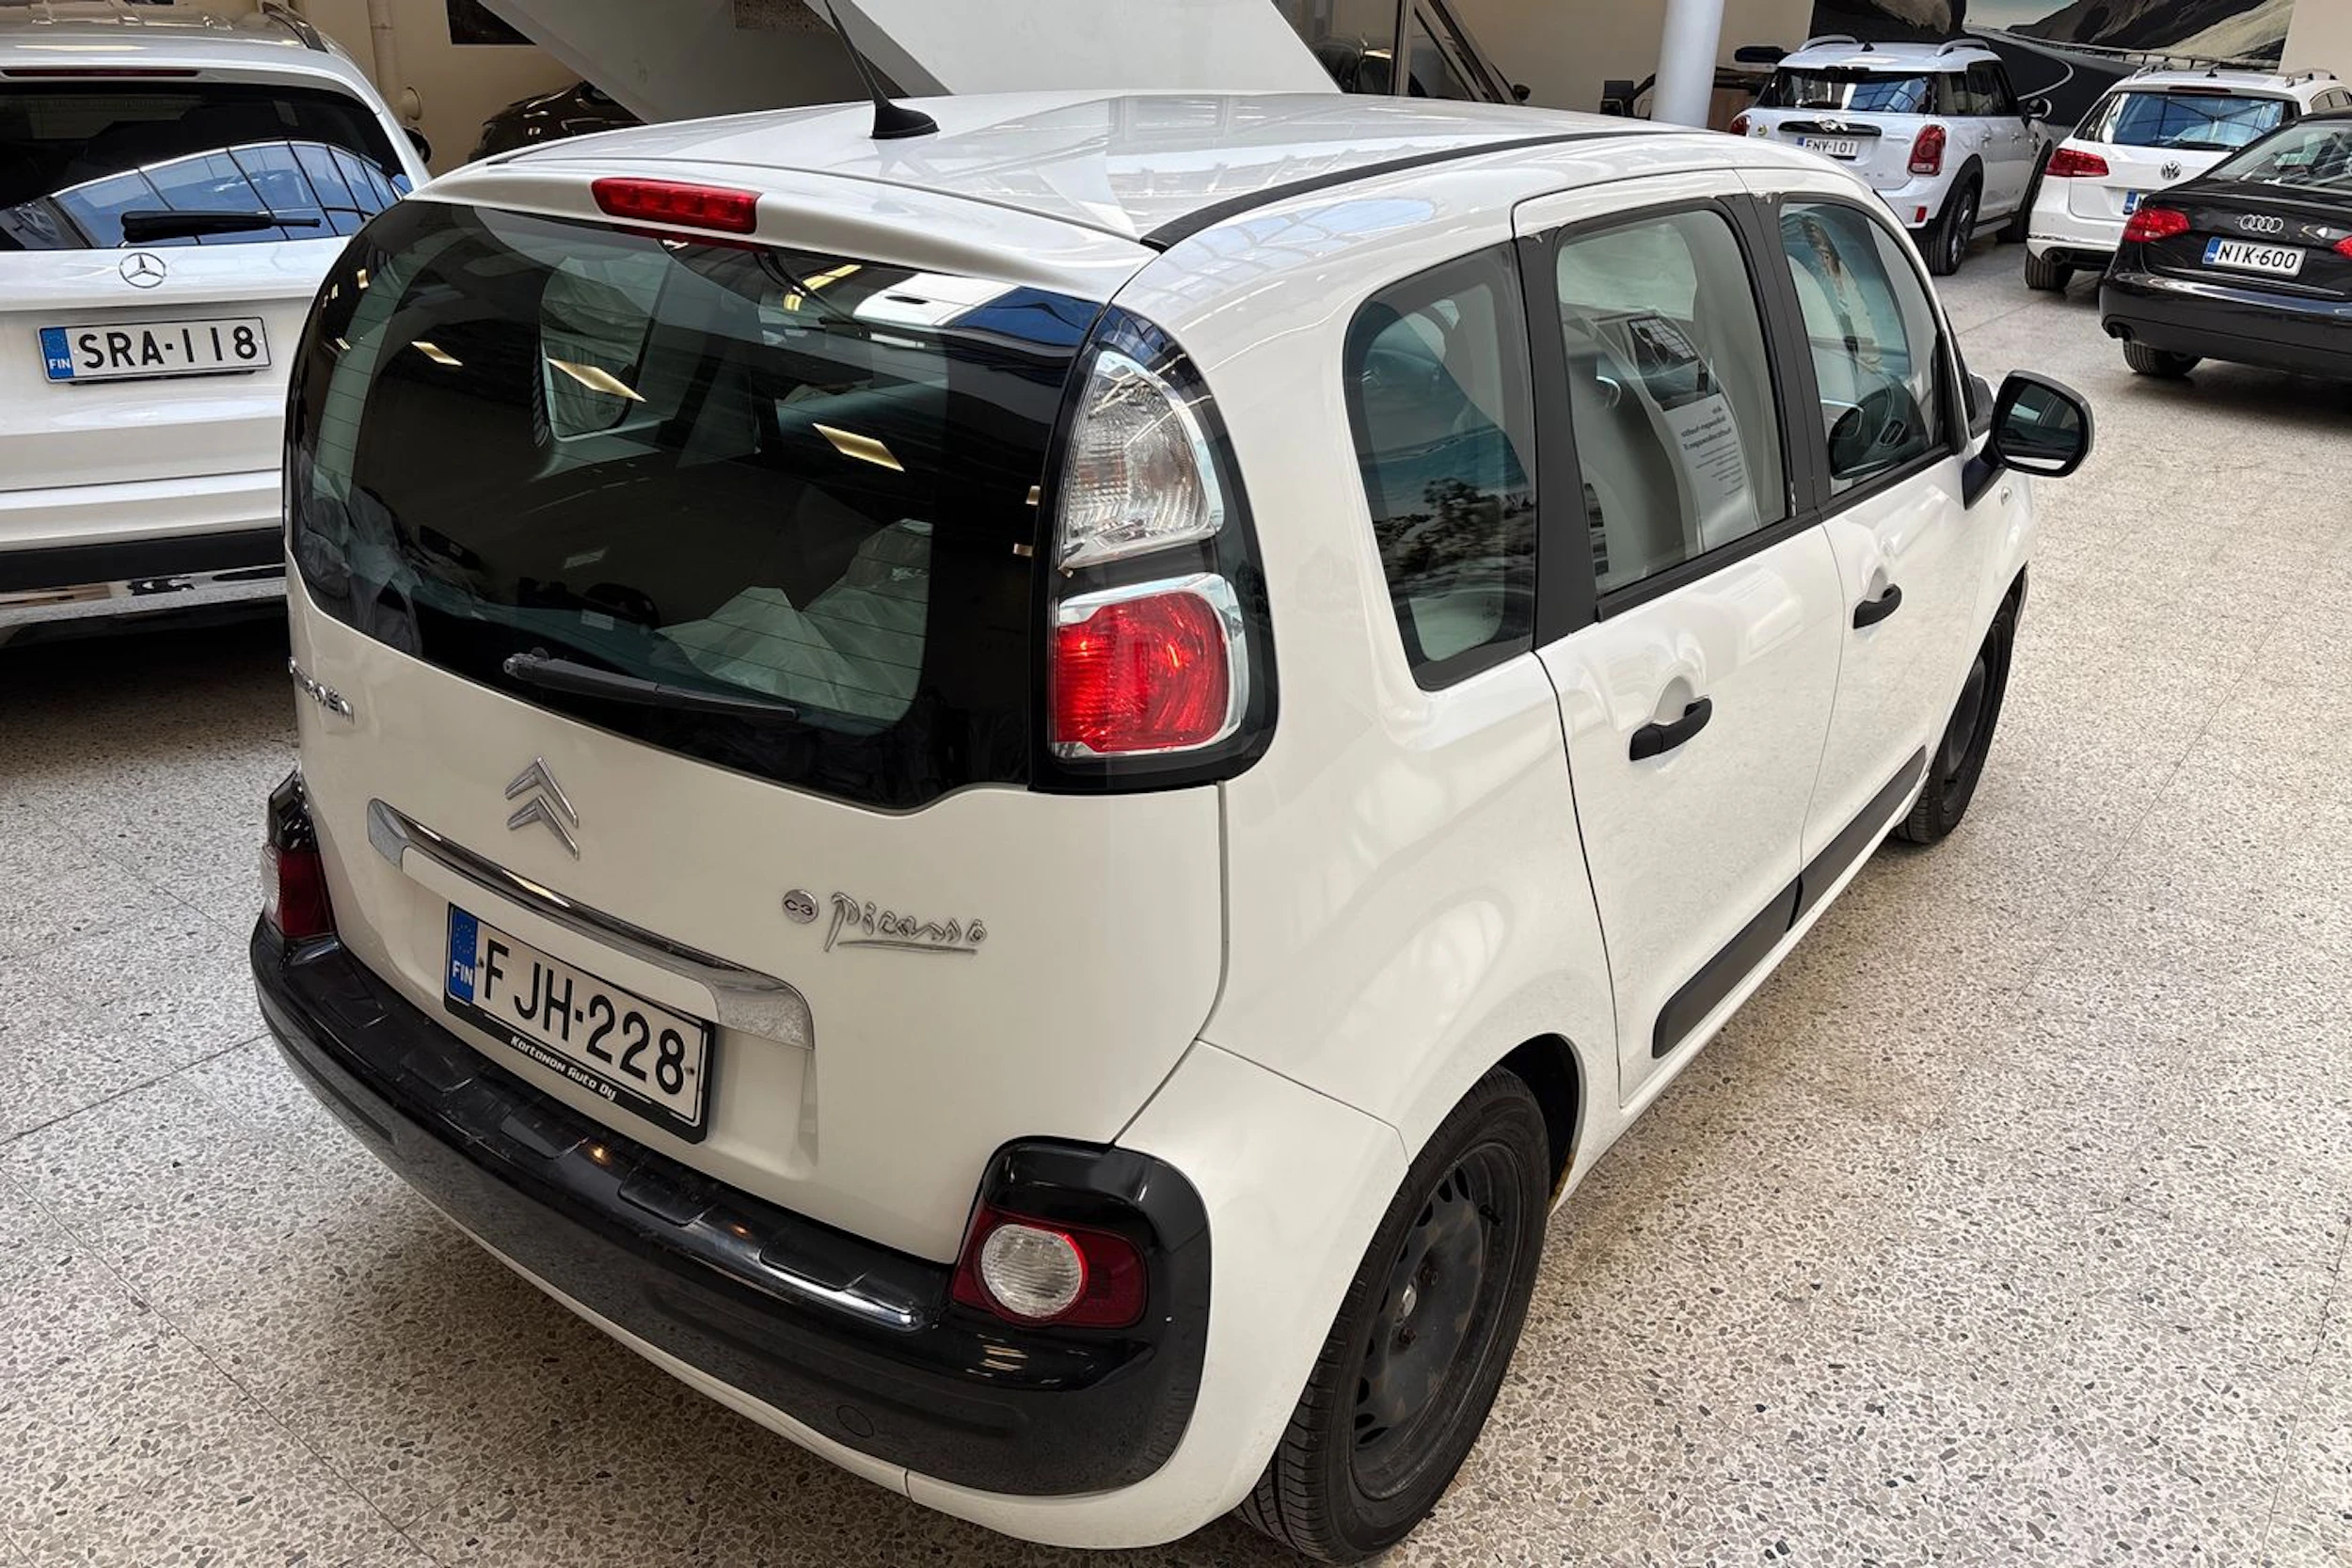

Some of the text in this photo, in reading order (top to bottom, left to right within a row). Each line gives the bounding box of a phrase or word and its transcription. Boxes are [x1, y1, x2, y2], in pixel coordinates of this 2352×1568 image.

[2219, 244, 2297, 269] NIK-600
[49, 357, 72, 370] FIN
[78, 325, 258, 369] SRA-118
[824, 892, 988, 953] Picasso
[452, 959, 474, 987] FIN
[485, 939, 685, 1095] FJH-228
[566, 1066, 597, 1090] Auto
[598, 1082, 618, 1101] Oy
